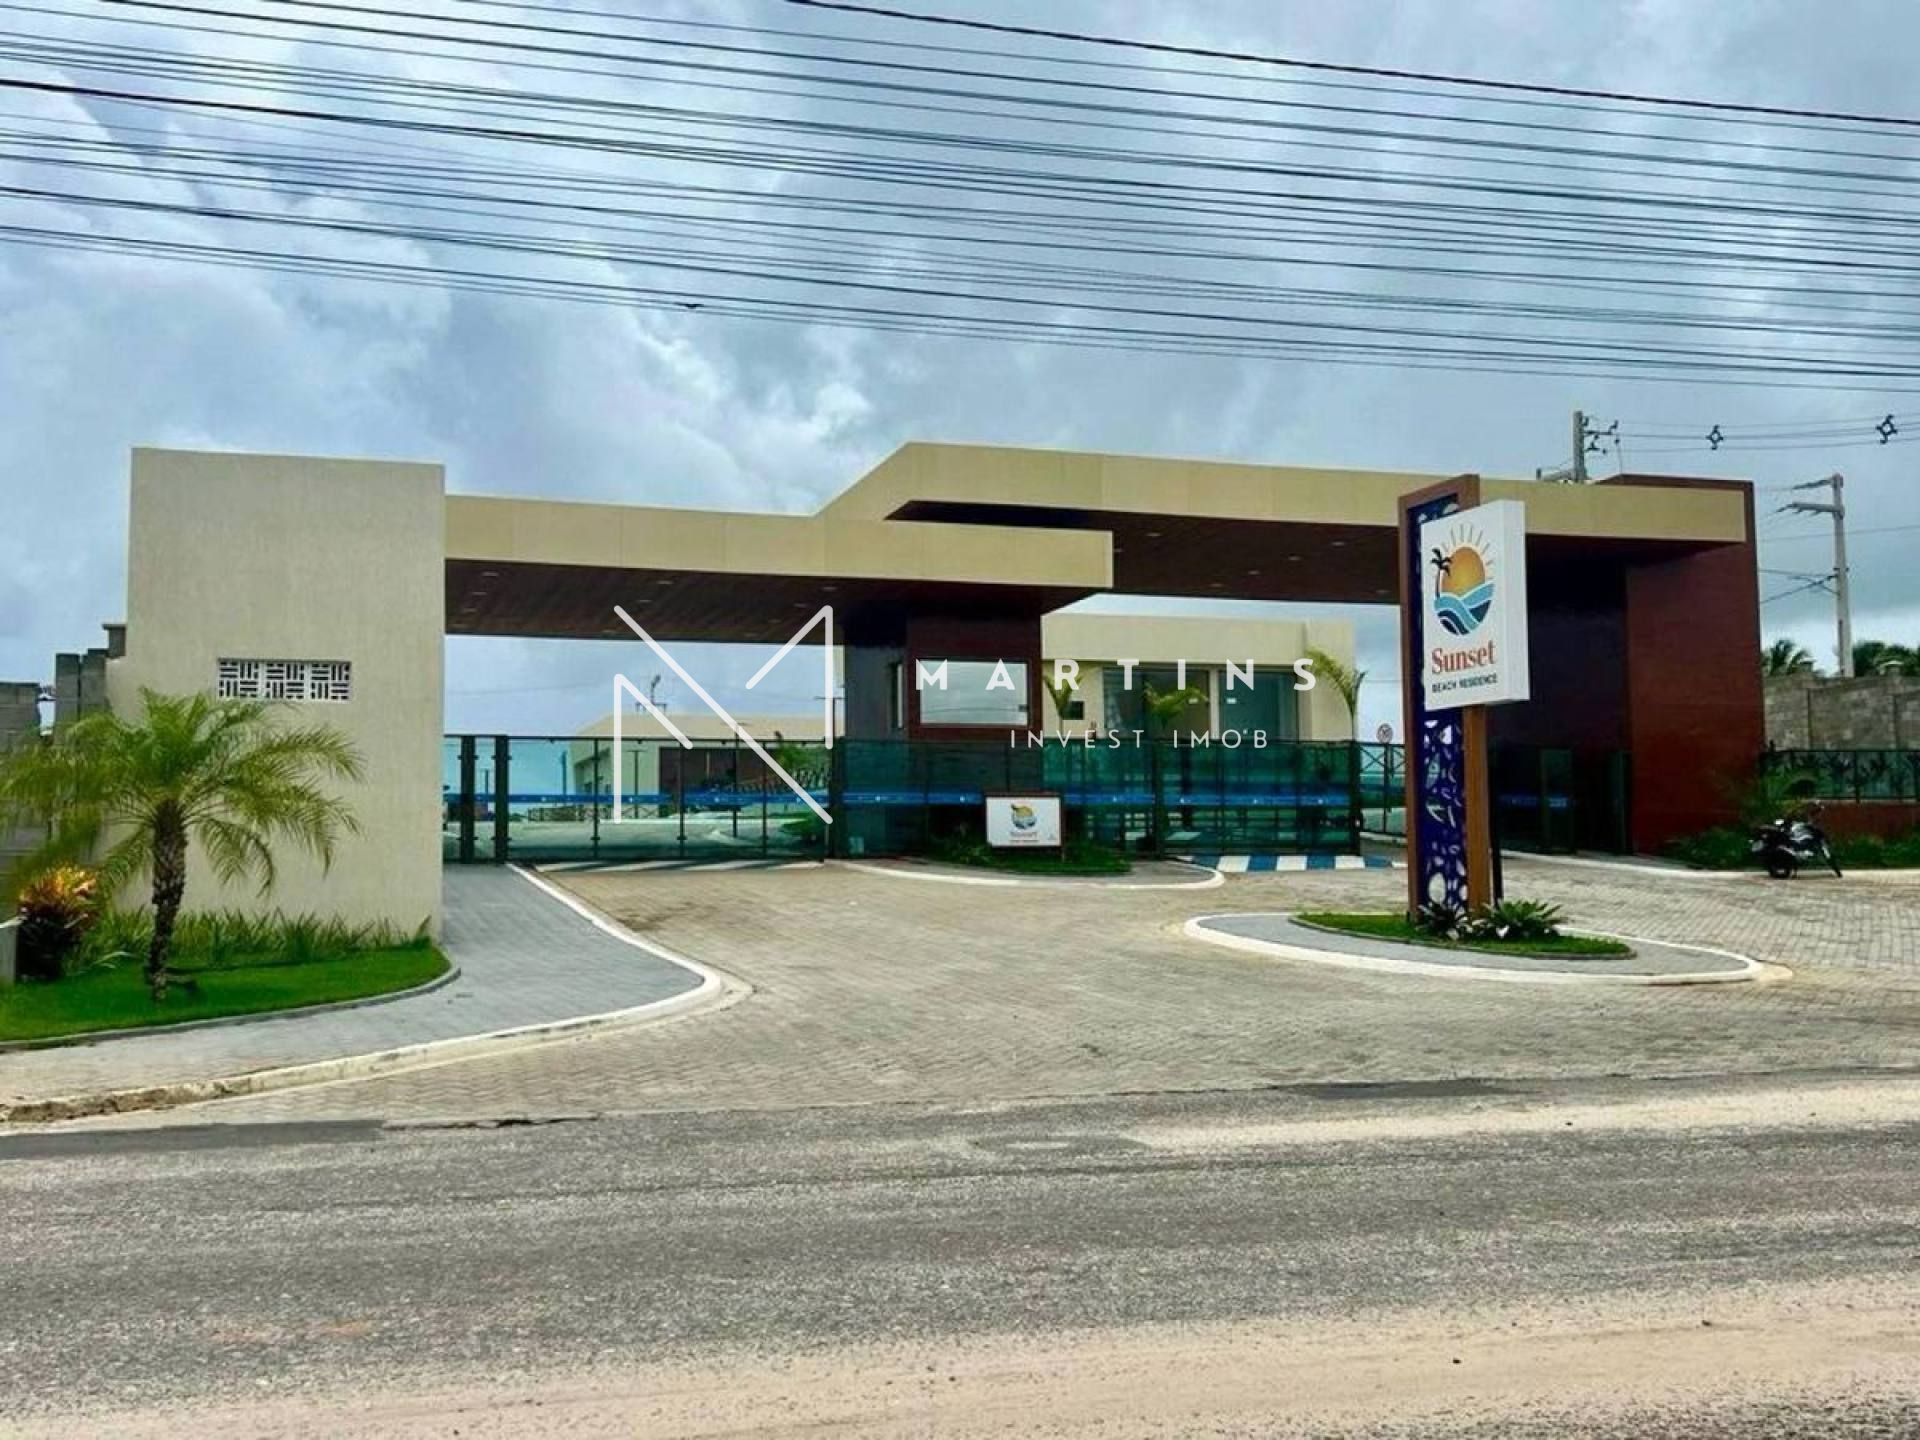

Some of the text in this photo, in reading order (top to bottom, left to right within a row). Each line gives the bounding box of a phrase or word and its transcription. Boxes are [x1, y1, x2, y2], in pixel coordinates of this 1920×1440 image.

[1431, 640, 1497, 674] Sunset
[1431, 673, 1498, 693] BEACH RESIDENCE
